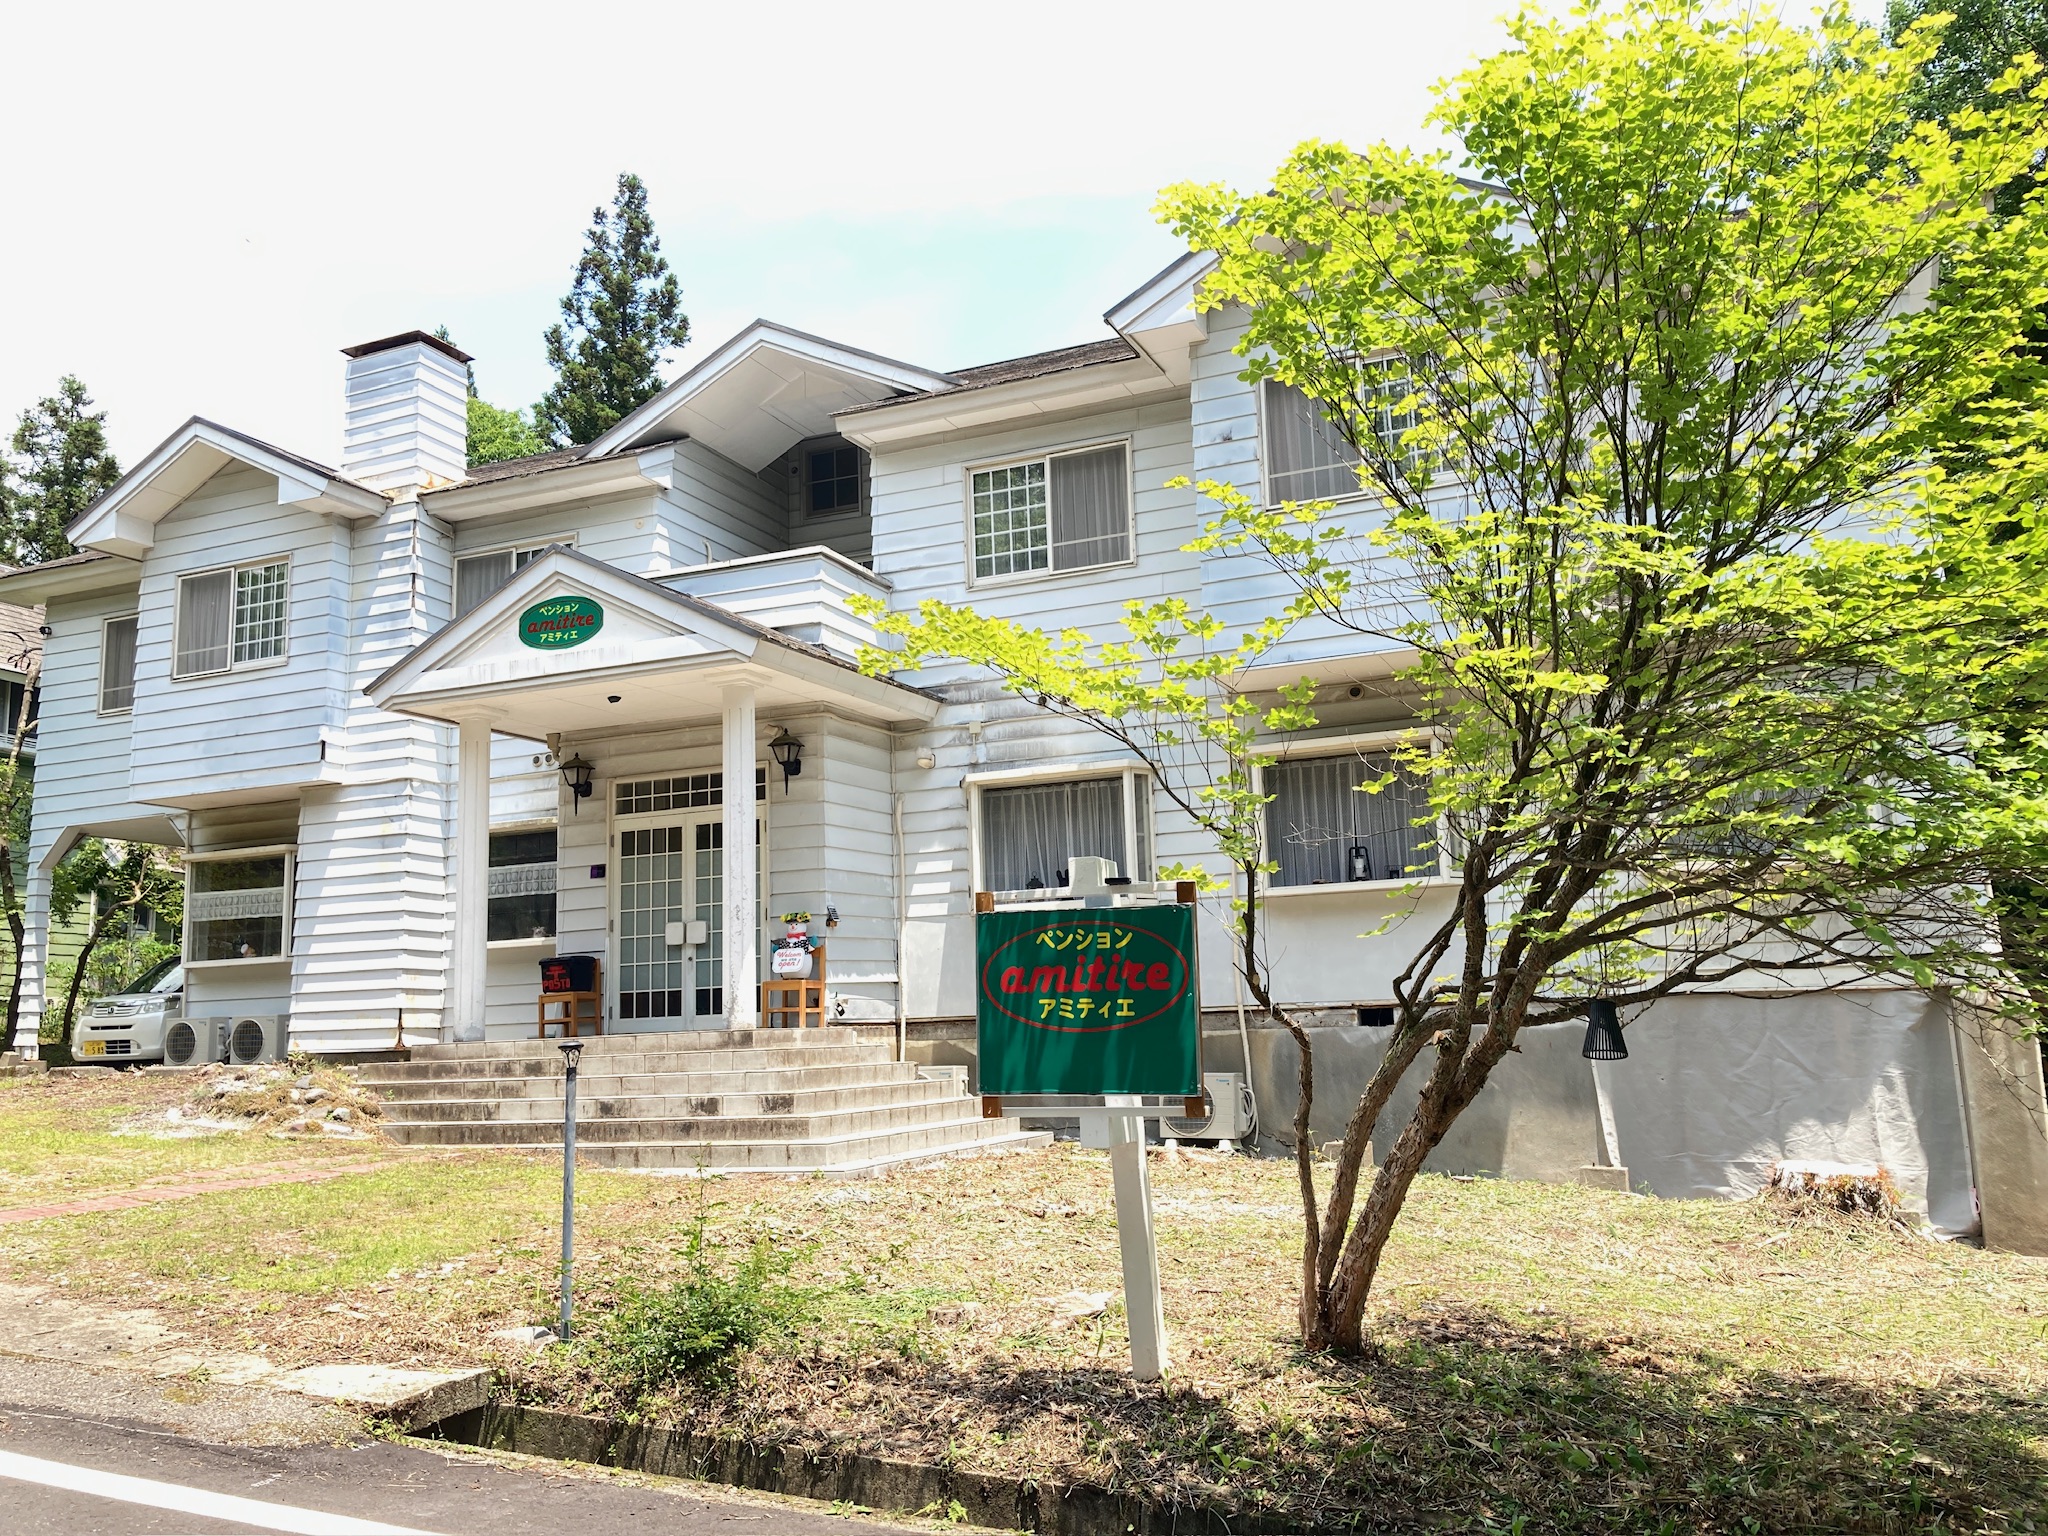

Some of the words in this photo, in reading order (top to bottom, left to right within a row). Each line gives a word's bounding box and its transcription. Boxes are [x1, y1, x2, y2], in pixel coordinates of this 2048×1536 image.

[539, 603, 579, 616] ペンション
[528, 613, 594, 634] amitire
[540, 630, 578, 642] アミティエ
[1036, 928, 1134, 950] ペンション
[1000, 954, 1171, 994] amitire
[1038, 998, 1136, 1019] アミティエ
